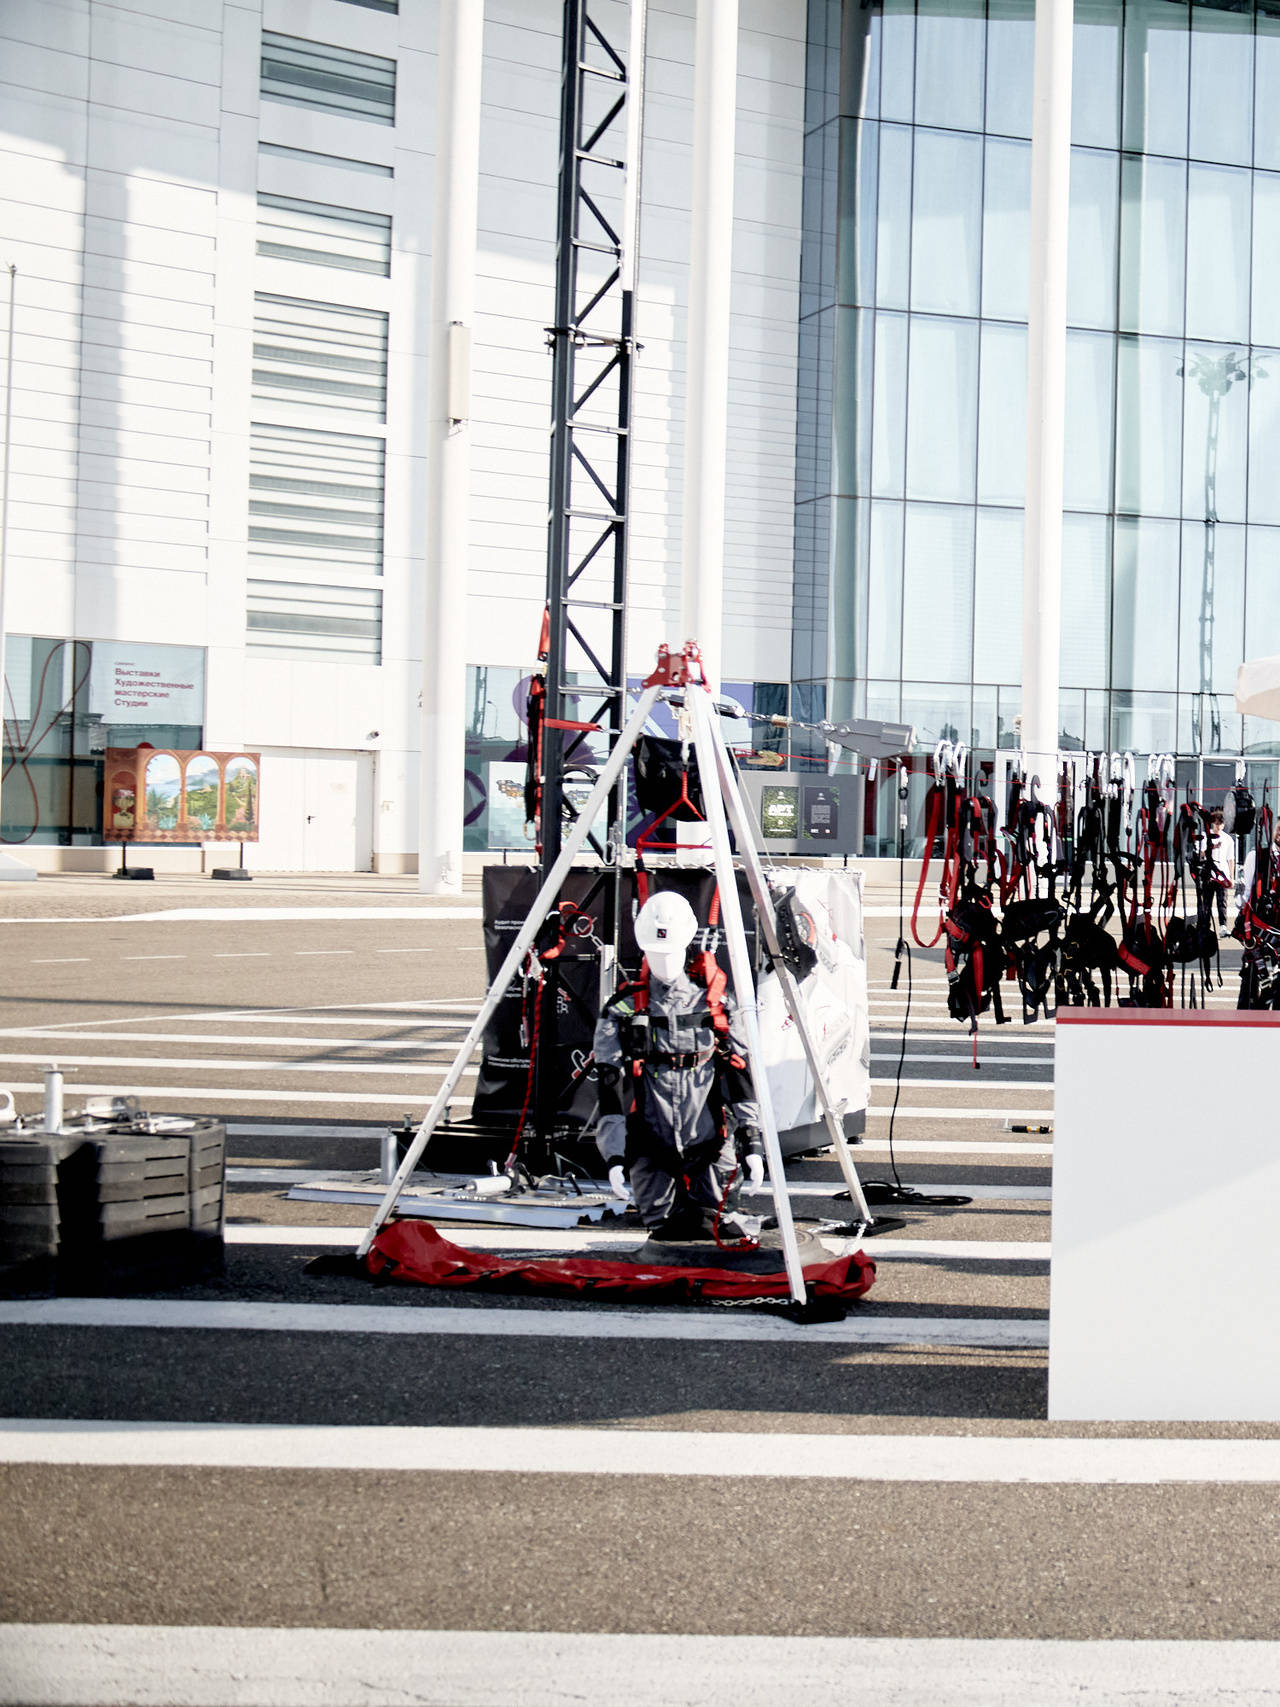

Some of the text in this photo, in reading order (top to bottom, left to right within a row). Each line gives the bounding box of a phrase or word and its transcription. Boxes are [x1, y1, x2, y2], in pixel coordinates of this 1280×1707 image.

[115, 668, 161, 677] Выставки
[115, 679, 194, 690] Художественные
[114, 690, 170, 698] мастерские
[114, 699, 148, 707] Студии
